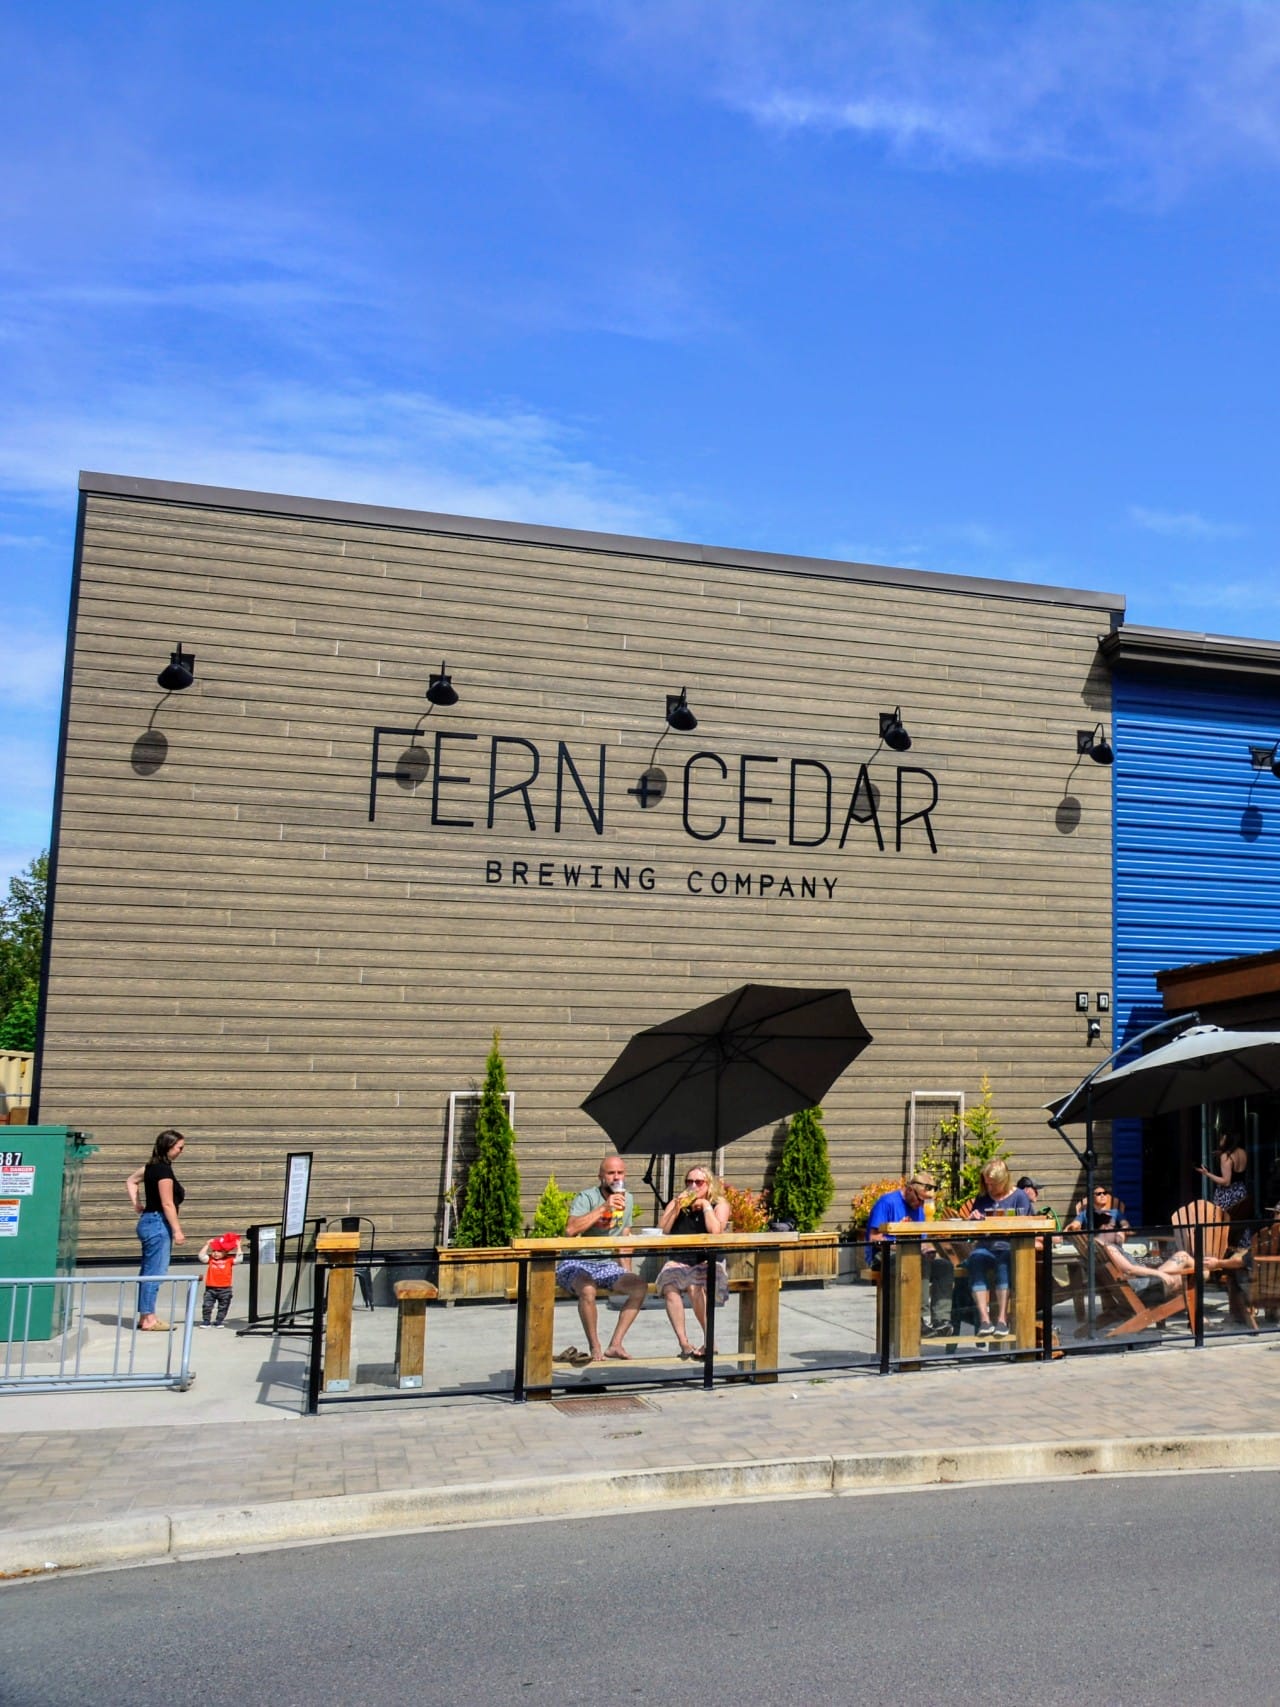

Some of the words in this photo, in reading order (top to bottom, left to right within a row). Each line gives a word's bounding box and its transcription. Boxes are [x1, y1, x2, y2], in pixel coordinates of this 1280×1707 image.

[368, 727, 606, 835] FERN
[683, 751, 938, 854] CEDAR
[486, 860, 656, 891] BREWING
[687, 871, 838, 899] COMPANY
